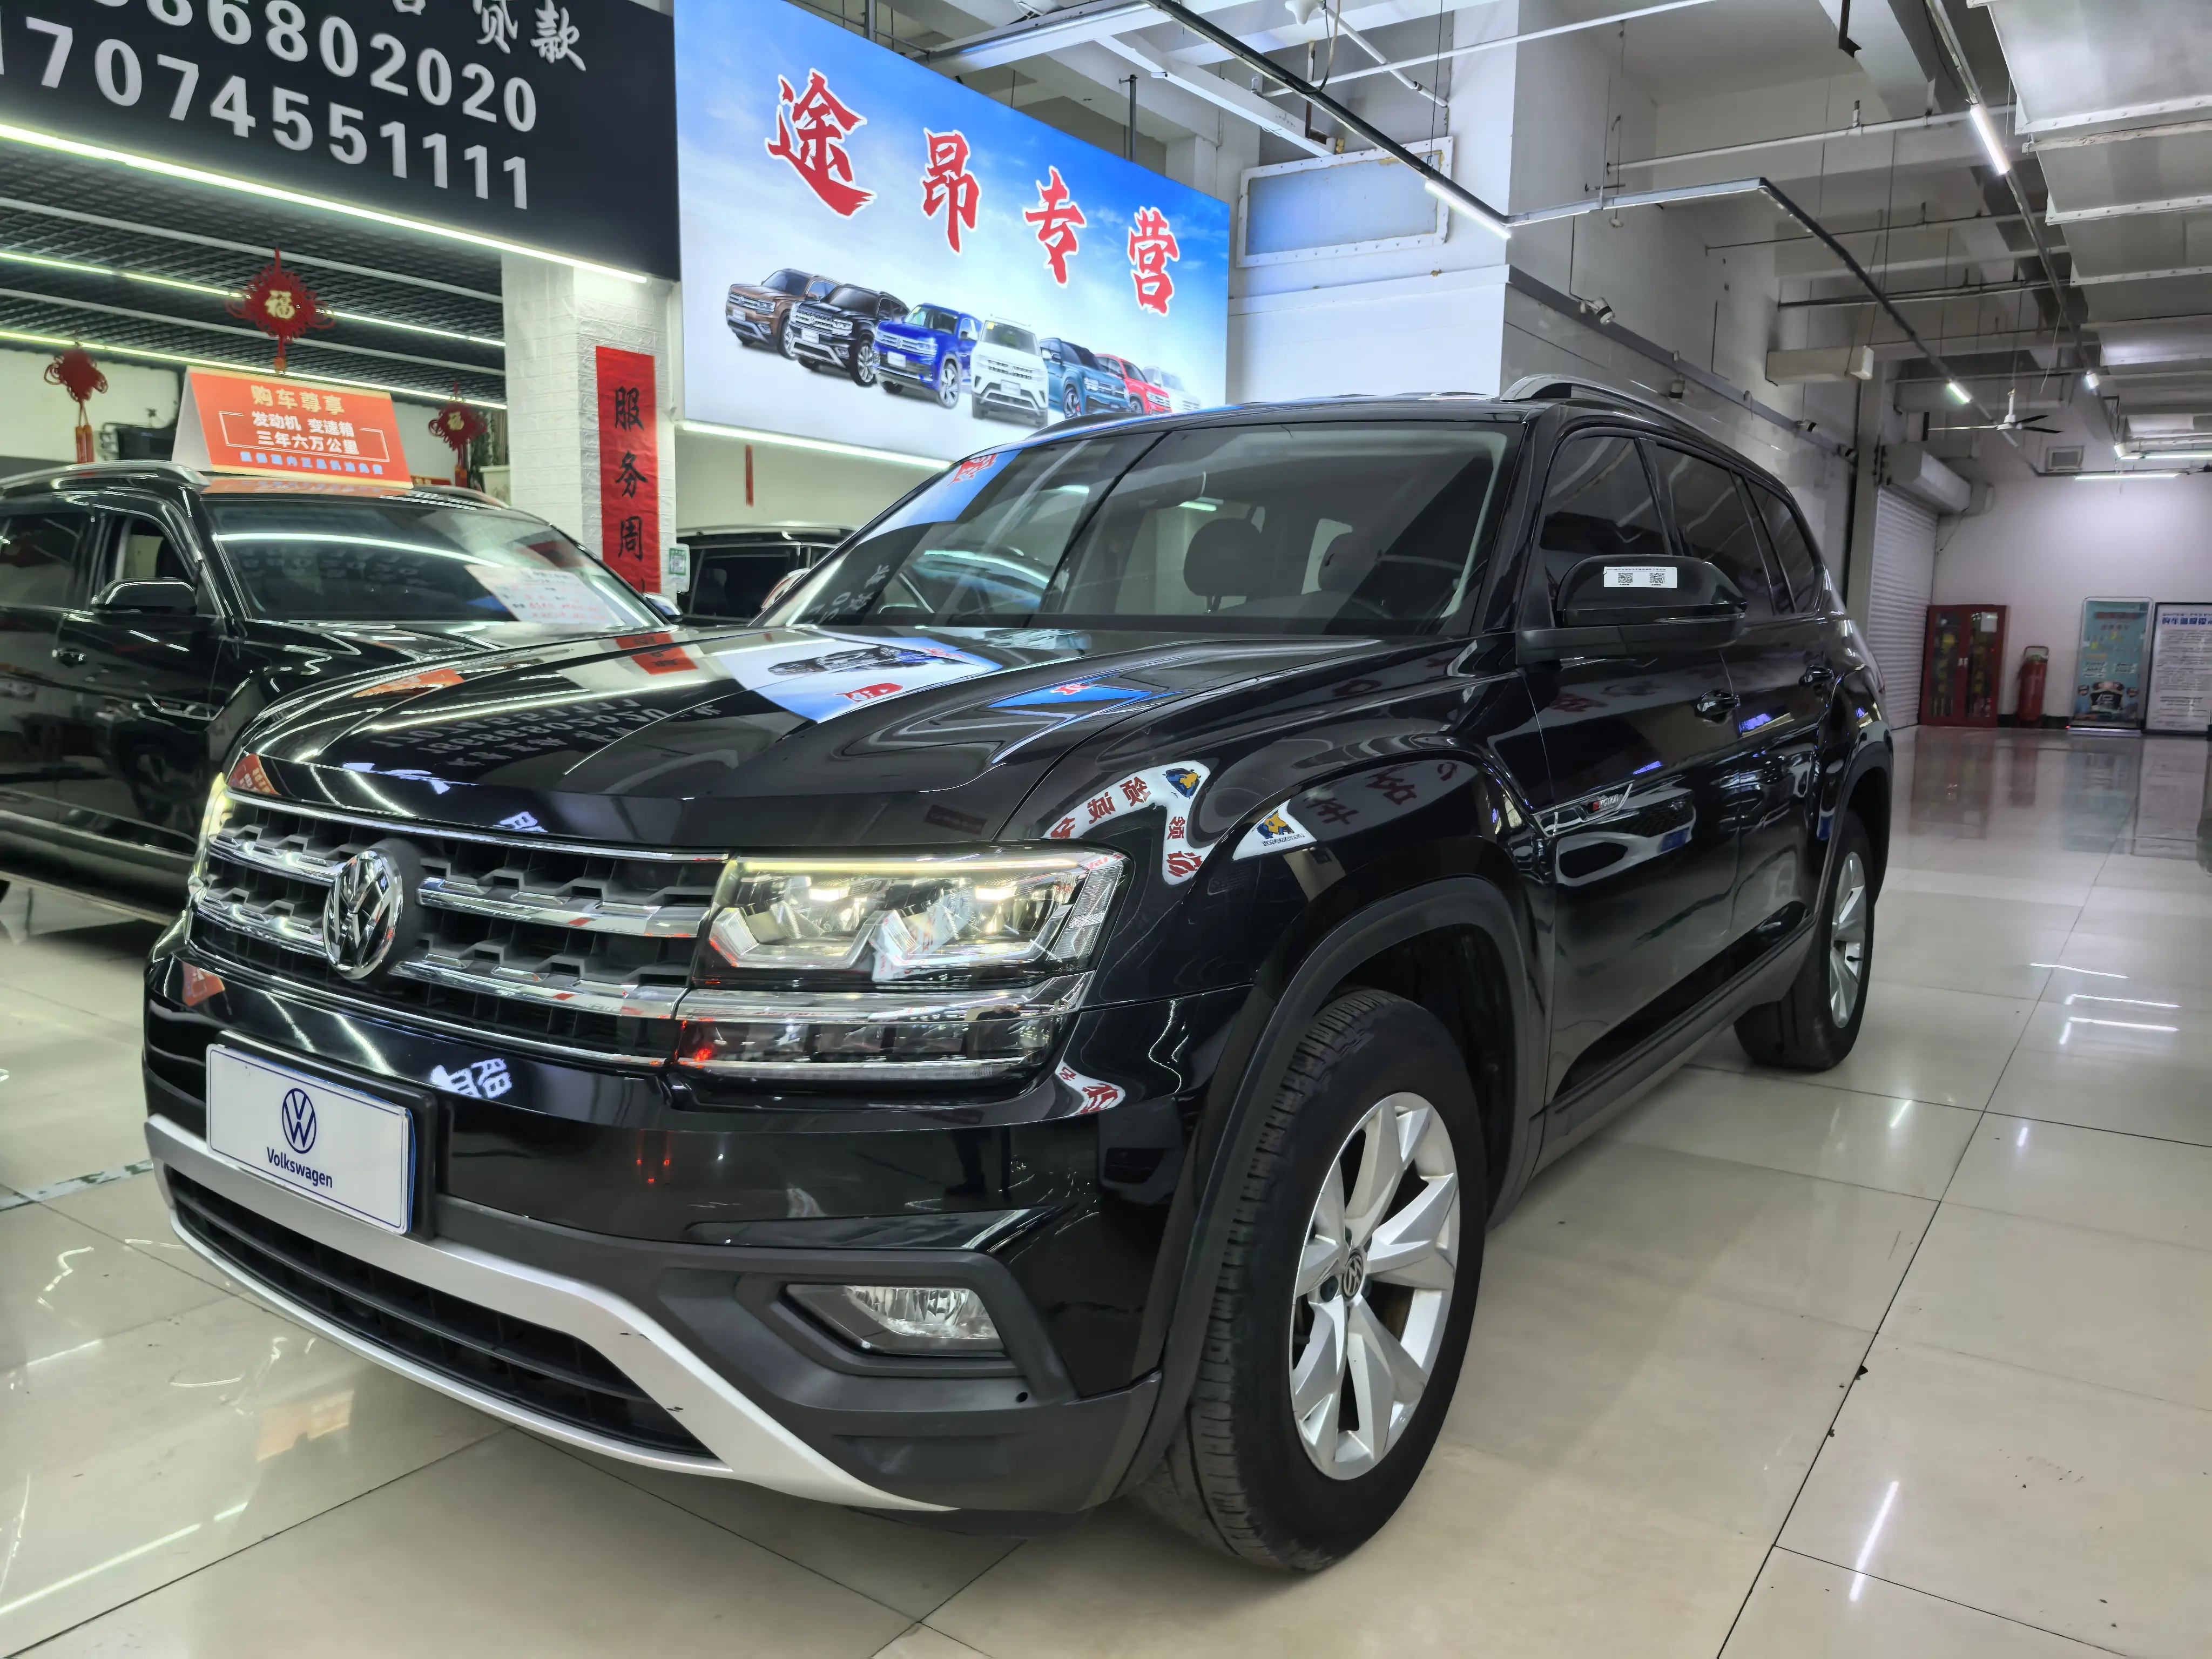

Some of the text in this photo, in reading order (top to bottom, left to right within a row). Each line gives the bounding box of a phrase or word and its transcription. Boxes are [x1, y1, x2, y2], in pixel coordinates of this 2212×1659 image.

[95, 0, 536, 132] 6802020
[0, 11, 528, 210] 7074551111
[767, 70, 1179, 315] 途昂专营
[251, 385, 345, 415] 购车尊享
[252, 411, 355, 437] 发动机 变速箱
[257, 430, 360, 455] 三年六万公里
[615, 386, 648, 594] 服务周
[267, 1147, 333, 1189] Volkswagen
